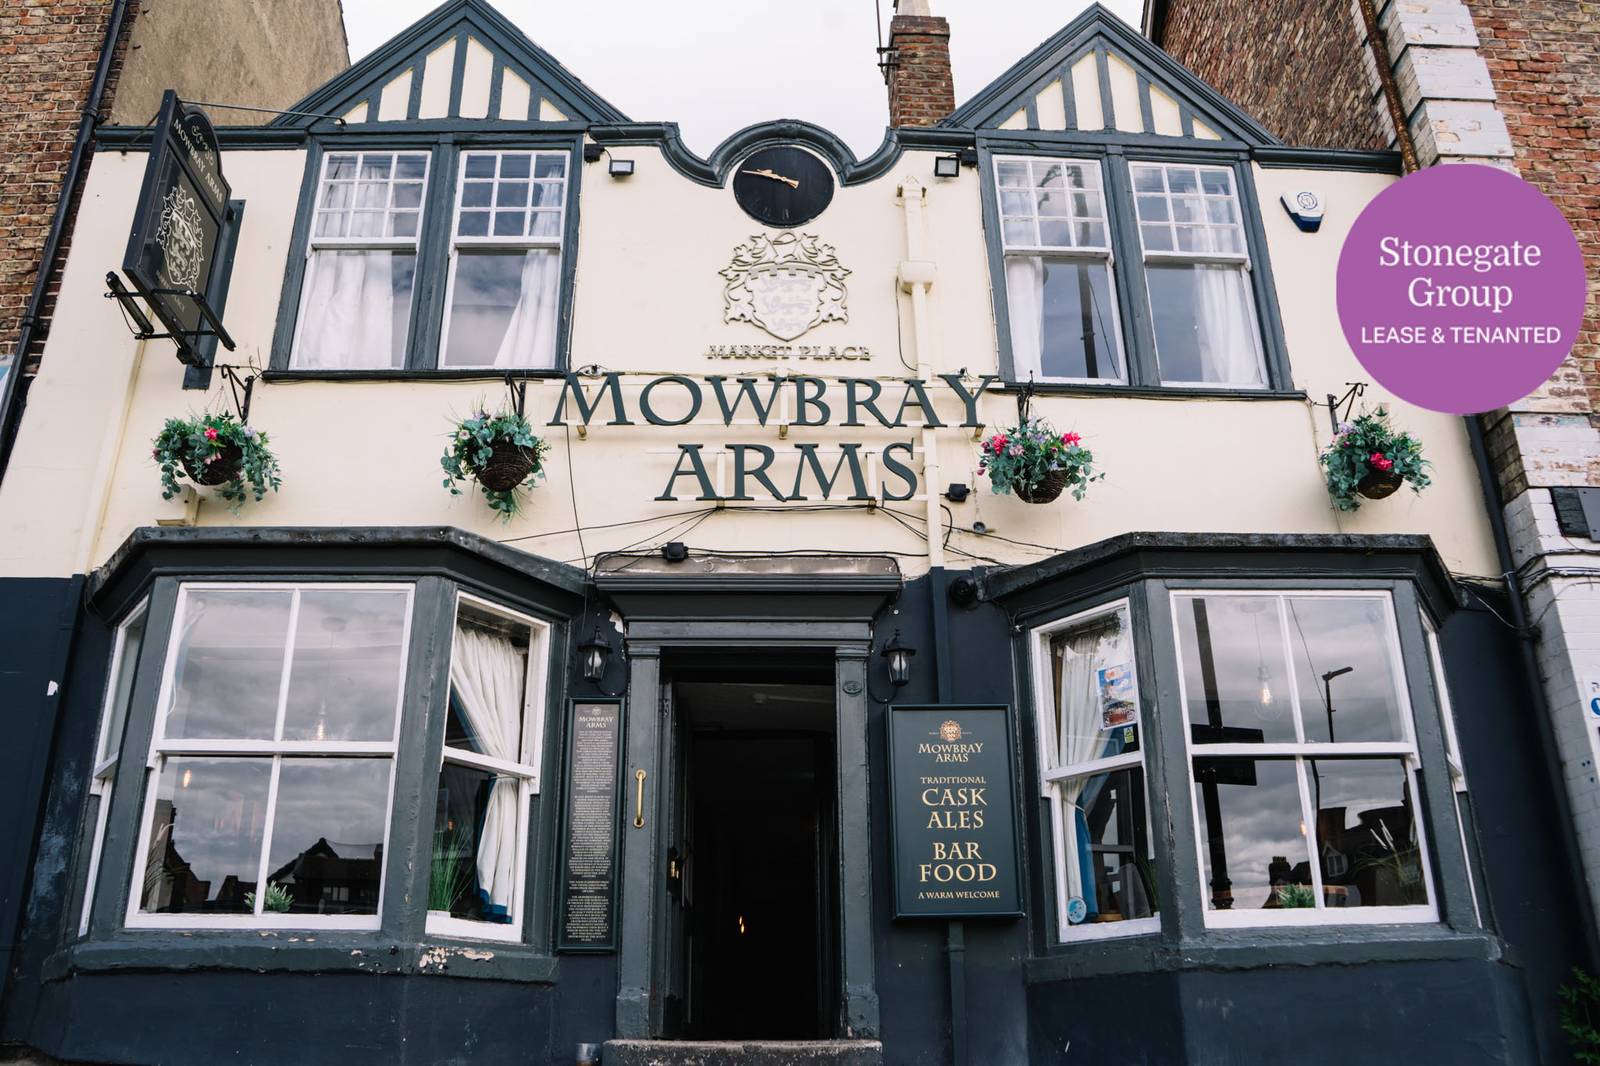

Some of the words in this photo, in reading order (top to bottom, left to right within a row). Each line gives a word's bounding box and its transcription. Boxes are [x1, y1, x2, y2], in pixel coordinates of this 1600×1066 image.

[174, 119, 205, 172] MOWBRAY
[205, 172, 222, 203] ARMS
[706, 344, 792, 360] MARKET
[798, 345, 872, 361] PLACE
[546, 372, 999, 428] MOWBRAY
[654, 438, 918, 502] ARMS
[918, 743, 984, 754] MOWBRAY
[935, 753, 969, 763] ARMS
[920, 776, 987, 784] TRADITIONAL
[921, 787, 988, 807] CASK
[926, 810, 984, 831] ALES
[932, 842, 983, 860] BAR
[919, 863, 997, 882] FOOD
[956, 891, 1000, 899] WELCOME
